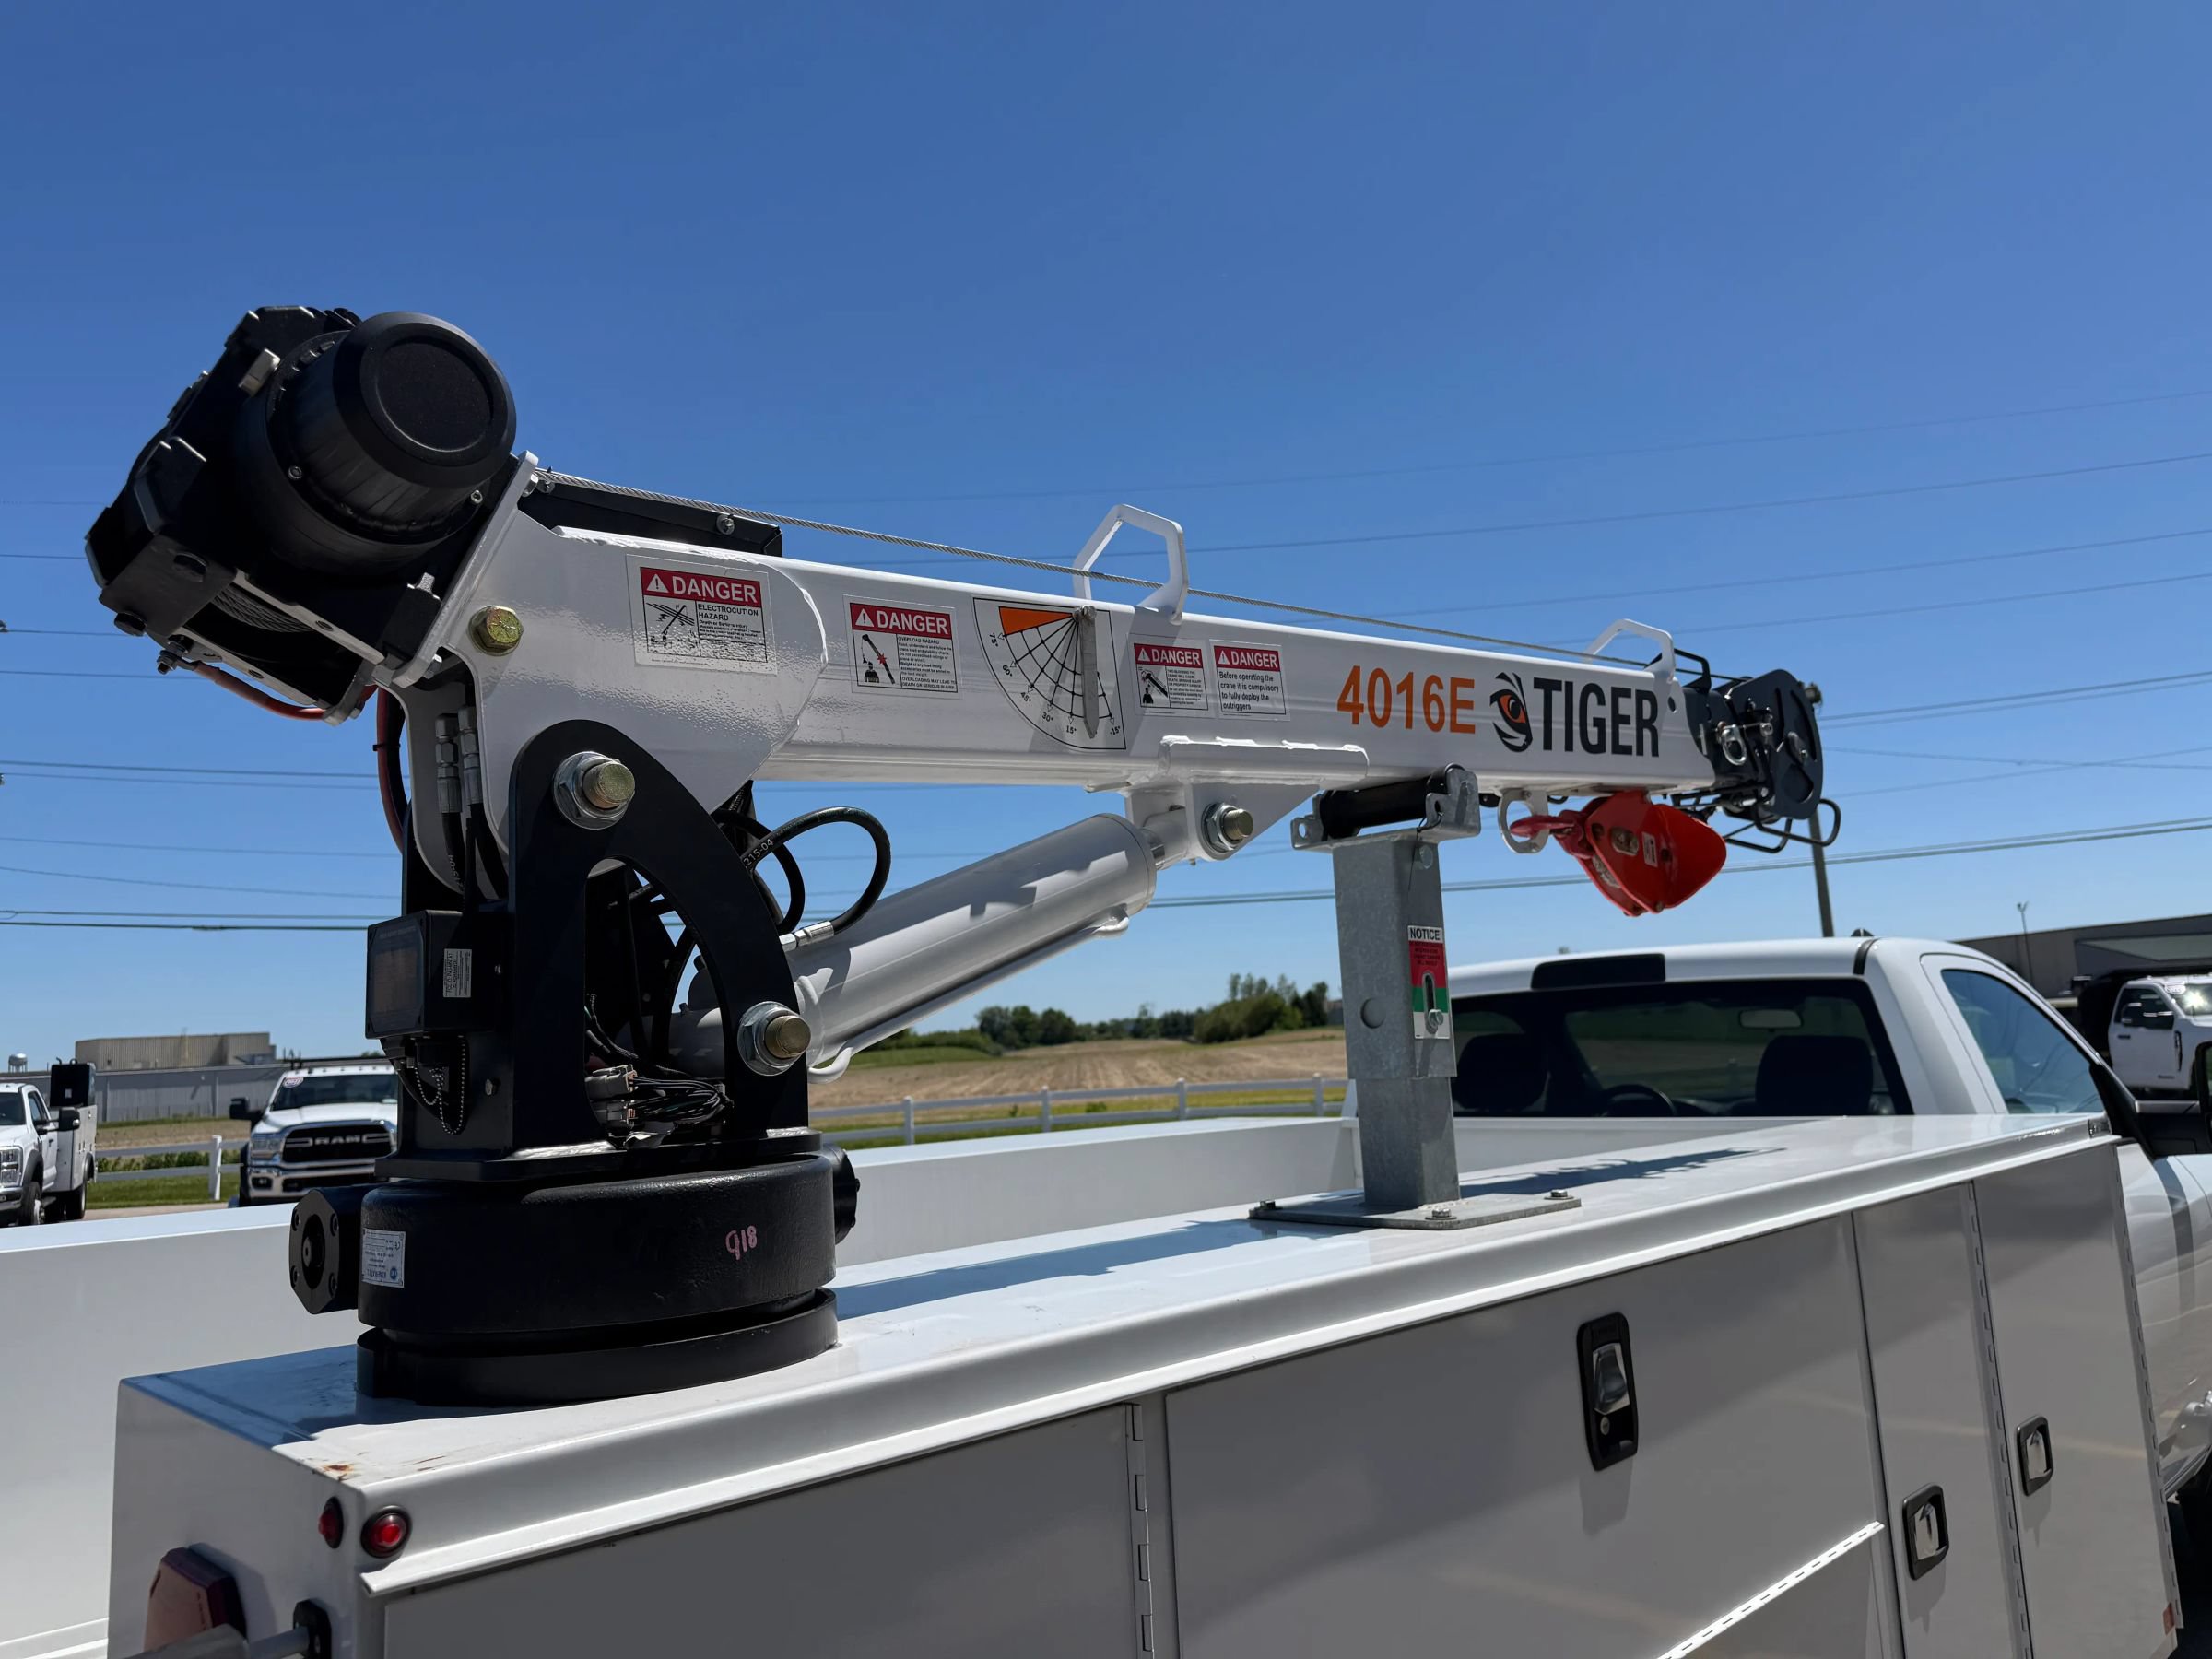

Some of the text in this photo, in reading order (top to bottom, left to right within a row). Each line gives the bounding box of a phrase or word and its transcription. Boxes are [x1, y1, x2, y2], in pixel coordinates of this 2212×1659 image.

[672, 575, 758, 603] DANGER
[698, 604, 759, 616] ELECTROCUTION
[698, 612, 728, 620] HAZARD
[877, 610, 948, 635] DANGER
[1152, 648, 1201, 665] DANGER
[1230, 651, 1278, 668] DANGER
[1218, 671, 1238, 680] Before
[1239, 674, 1265, 683] operating
[1248, 684, 1279, 693] compulsory
[1229, 691, 1241, 701] fully
[1241, 692, 1260, 702] deploy
[1261, 693, 1269, 701] the
[1223, 702, 1252, 712] outriggers
[1336, 665, 1660, 757] 4016E TIGER
[1410, 927, 1441, 940] NOTICE
[314, 1135, 361, 1146] RAM
[725, 1225, 758, 1261] 918
